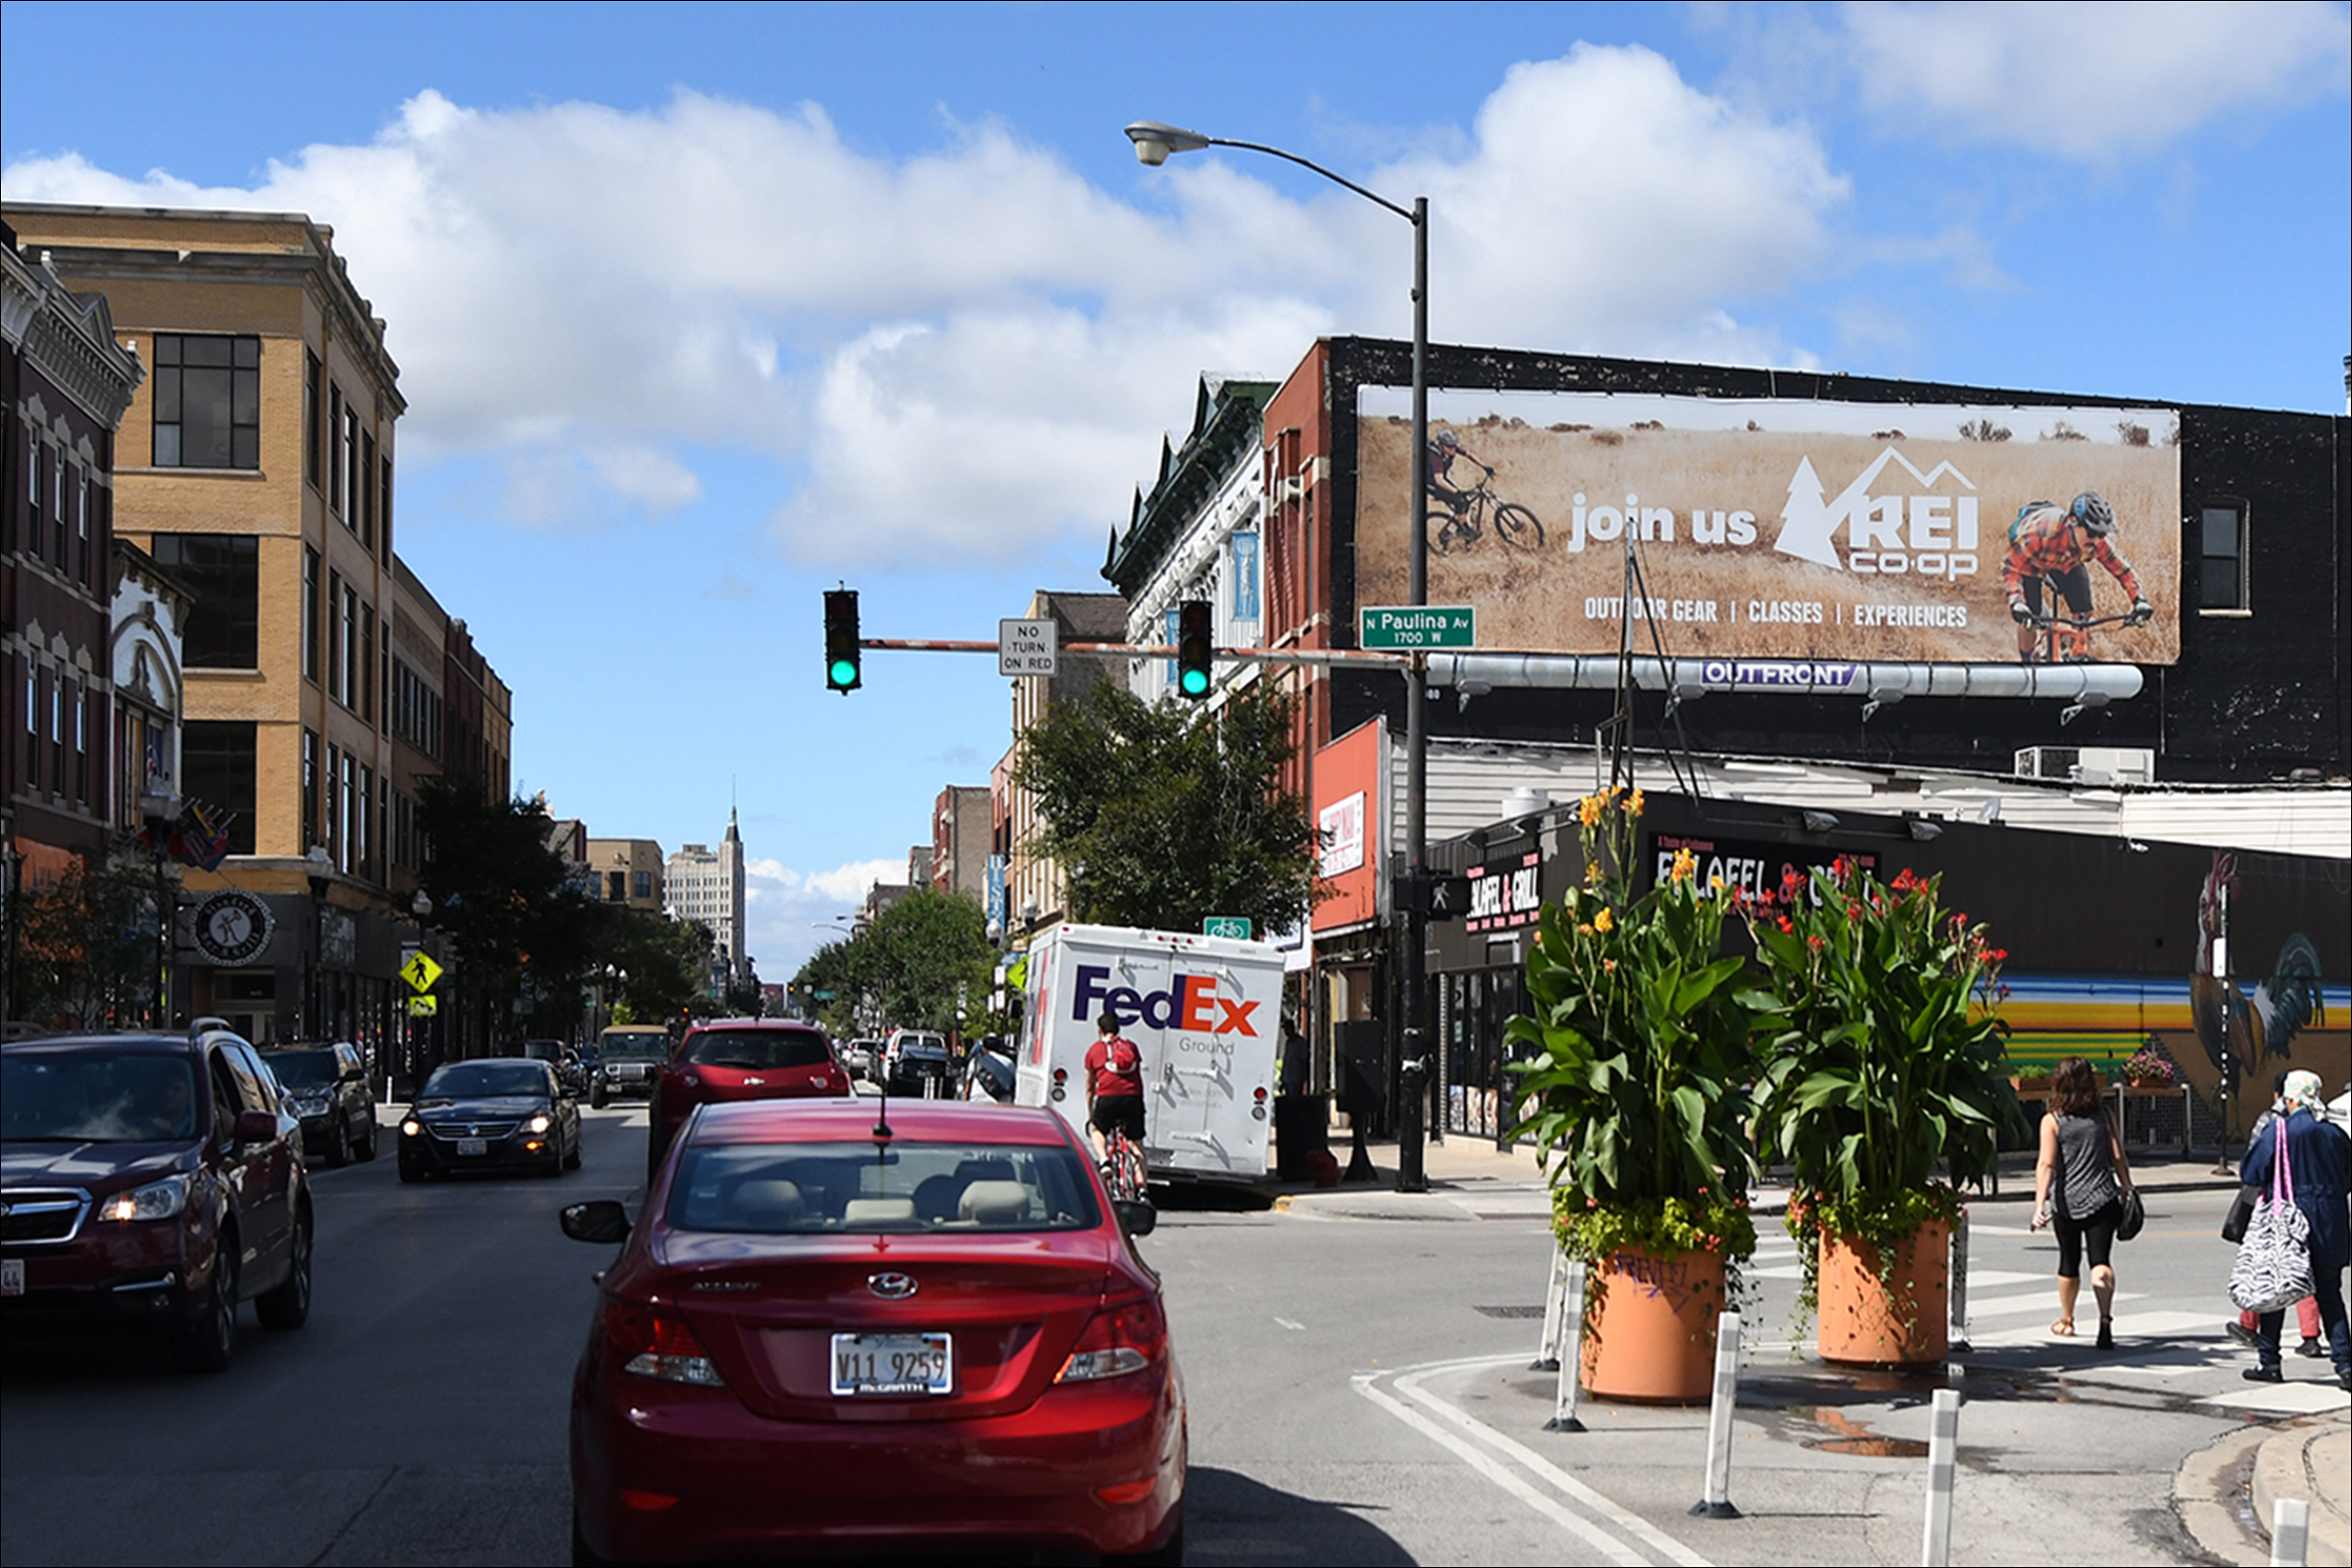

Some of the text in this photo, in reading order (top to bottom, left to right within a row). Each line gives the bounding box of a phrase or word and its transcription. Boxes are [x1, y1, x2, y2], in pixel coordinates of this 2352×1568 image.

[1568, 492, 1757, 553] join us
[1848, 494, 1980, 550] REI
[1366, 612, 1469, 630] N Paulina Av
[1585, 596, 1968, 628] OUTOOR GEAR CLASSES EXPERIENCES
[1017, 626, 1040, 638] NO
[1395, 632, 1442, 644] 1700 W
[1011, 642, 1046, 654] TURN
[1004, 658, 1053, 669] ON RED
[1705, 662, 1851, 684] OUTFRONT
[1502, 873, 1512, 913] &
[1512, 866, 1540, 912] GRILL
[1657, 851, 1765, 904] FLAFEL
[1072, 964, 1261, 1038] FedEx
[1179, 1037, 1236, 1055] Ground
[891, 1352, 946, 1382] 9259
